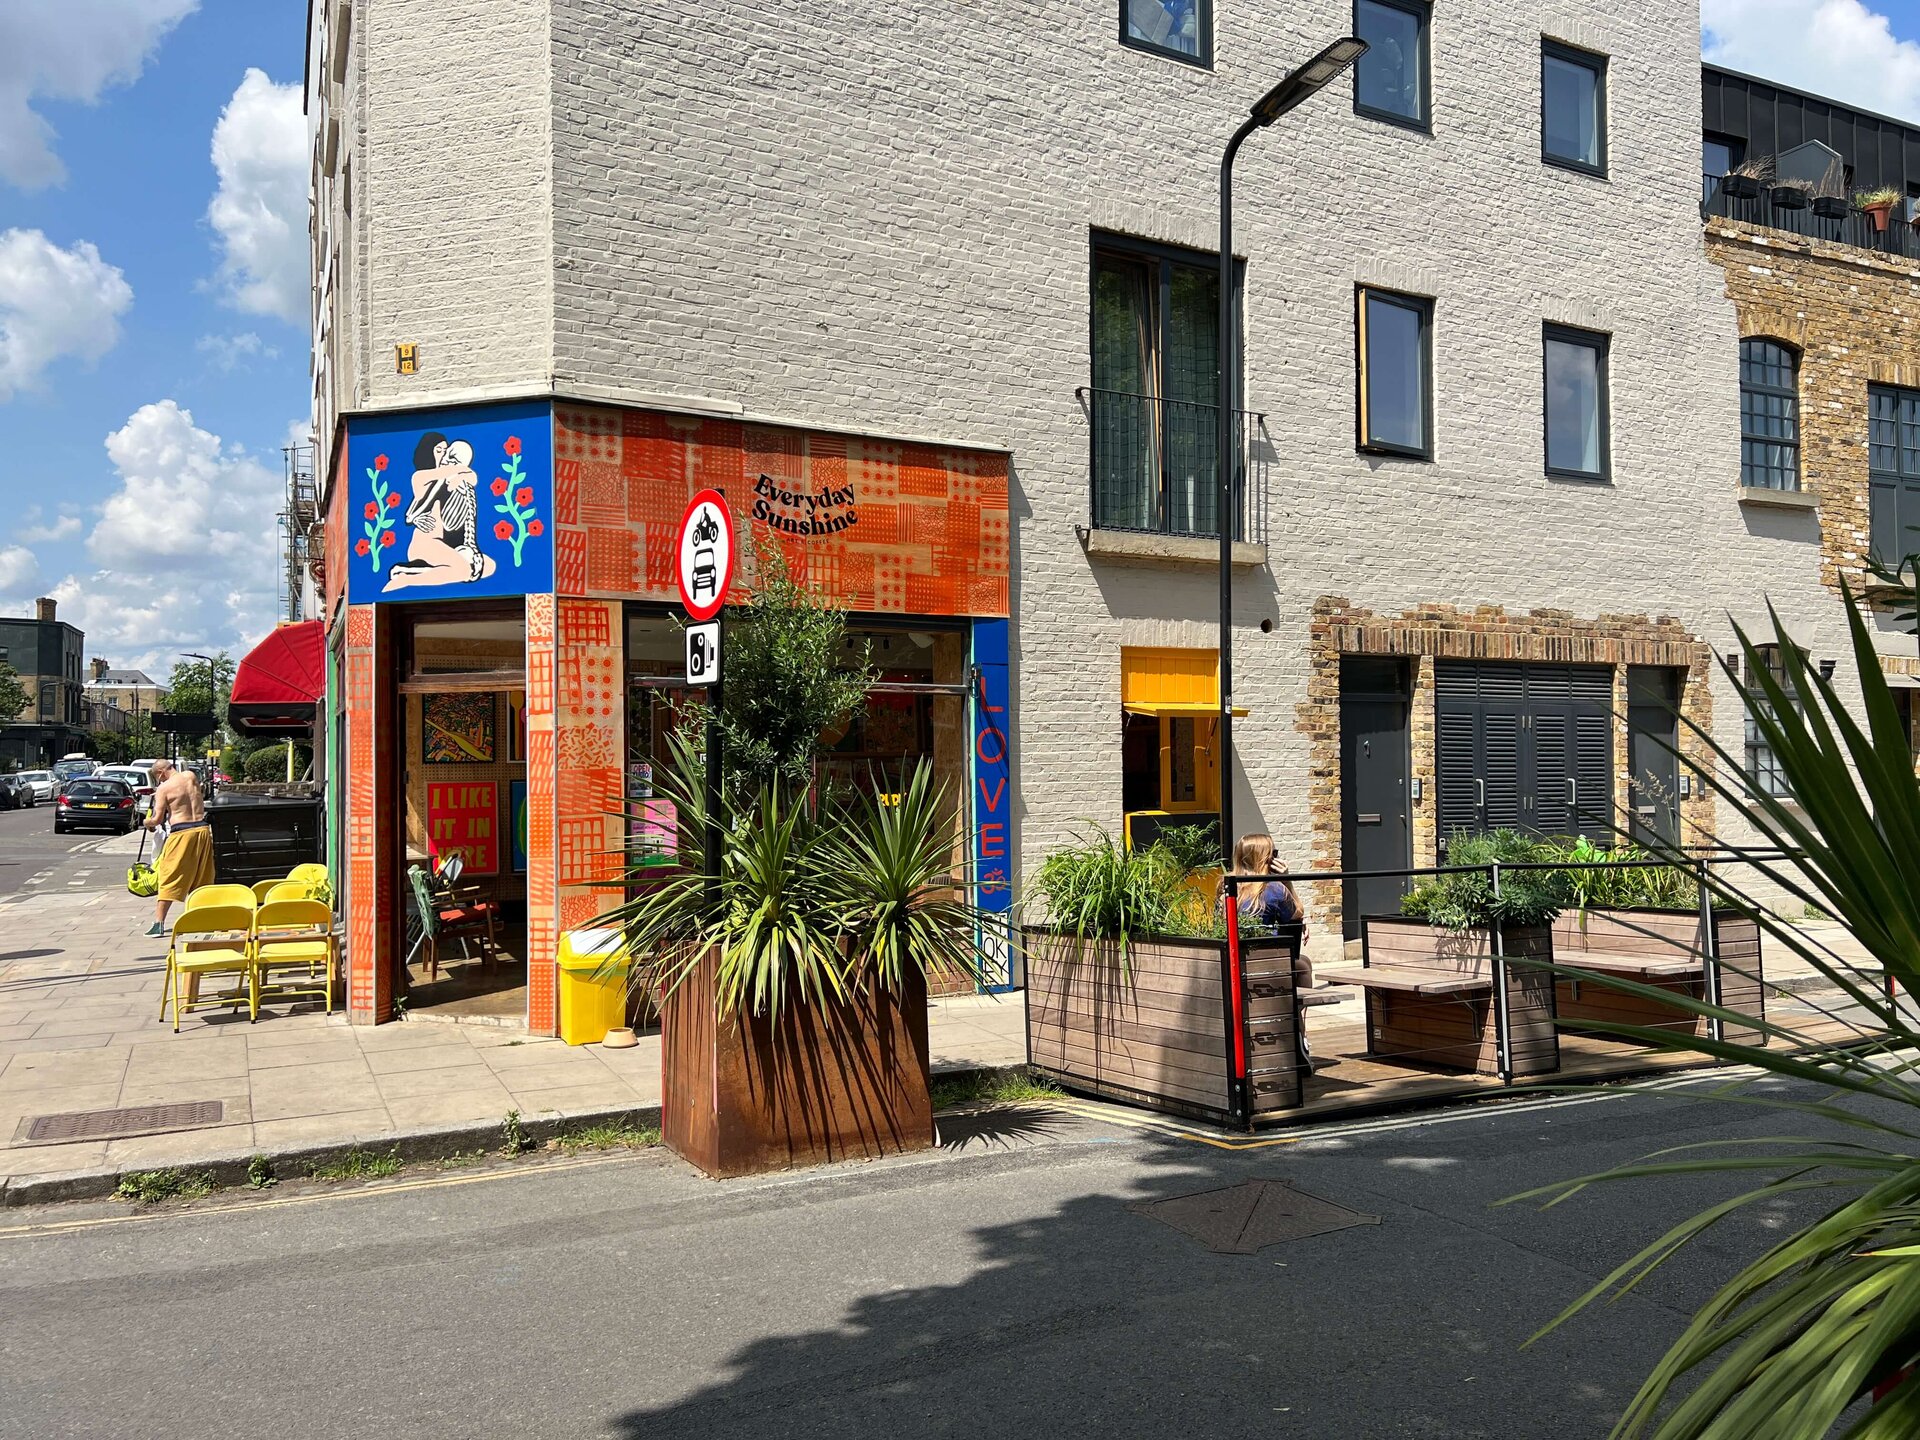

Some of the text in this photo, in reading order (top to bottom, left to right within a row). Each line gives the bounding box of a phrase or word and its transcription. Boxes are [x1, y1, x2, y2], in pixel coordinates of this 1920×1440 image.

[754, 473, 855, 515] Everyday
[752, 500, 858, 535] Sunshine
[976, 677, 1006, 856] LOVE
[432, 787, 491, 808] I LIKE
[434, 818, 490, 839] IT IN
[437, 845, 487, 867] HRE
[984, 935, 1007, 960] OK
